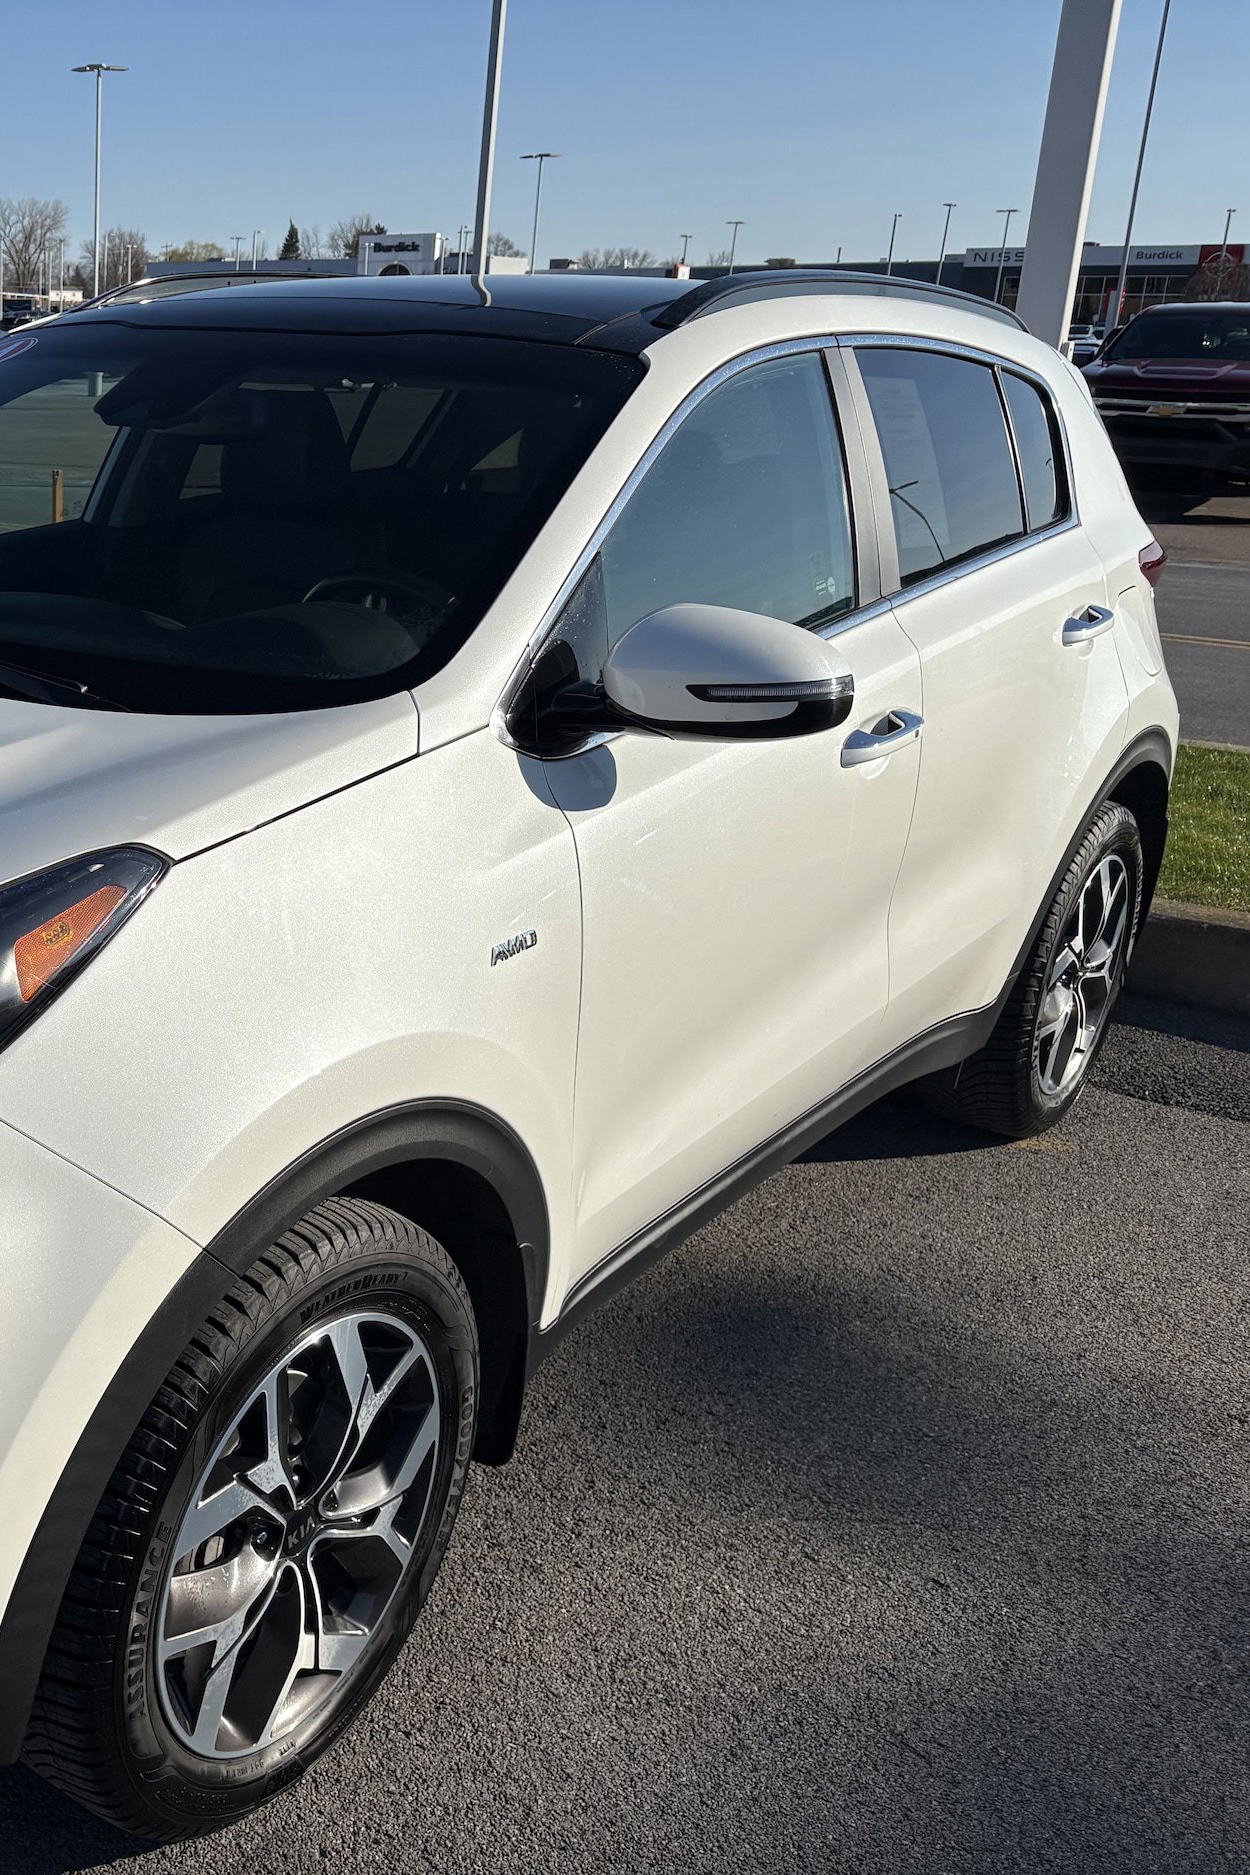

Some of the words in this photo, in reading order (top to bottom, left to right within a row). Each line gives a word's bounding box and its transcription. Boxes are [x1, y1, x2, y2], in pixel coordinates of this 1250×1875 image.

[373, 241, 420, 253] Burdick
[1135, 249, 1184, 260] Burdick
[490, 929, 538, 967] AWD
[287, 1515, 316, 1550] KIA
[128, 1519, 173, 1722] ASSURANCE
